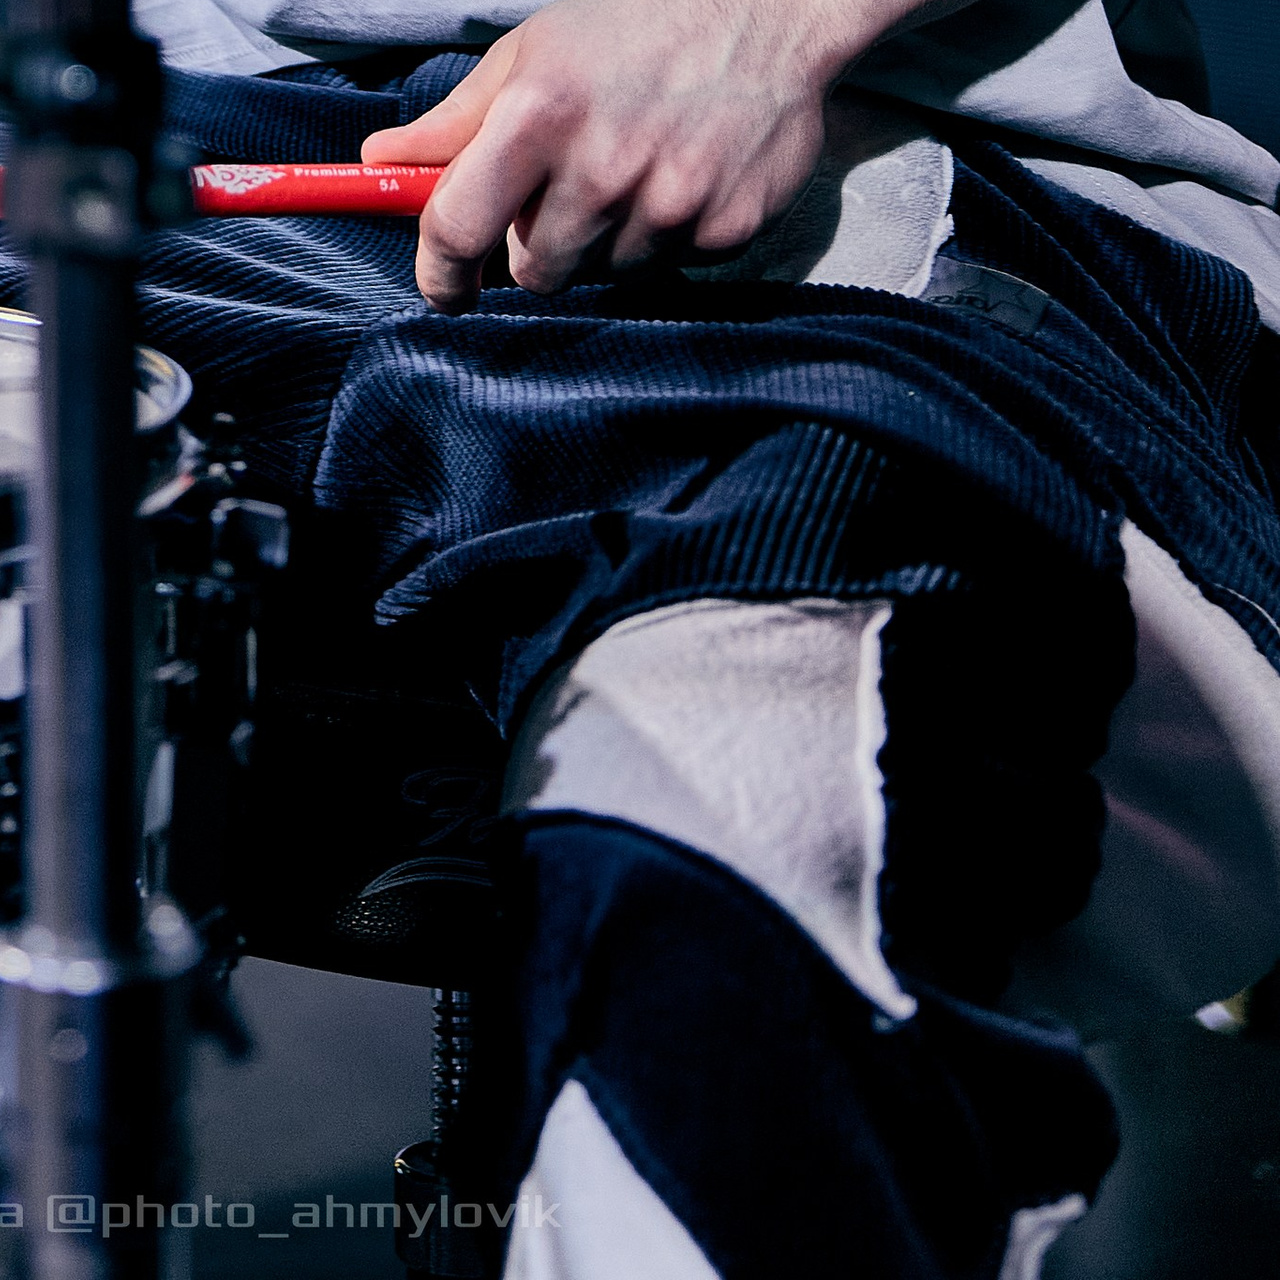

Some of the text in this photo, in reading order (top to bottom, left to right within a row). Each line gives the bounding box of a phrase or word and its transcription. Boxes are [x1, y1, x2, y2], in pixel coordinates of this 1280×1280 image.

[293, 166, 361, 177] Premium
[362, 166, 416, 178] Quality
[378, 178, 400, 192] 5A
